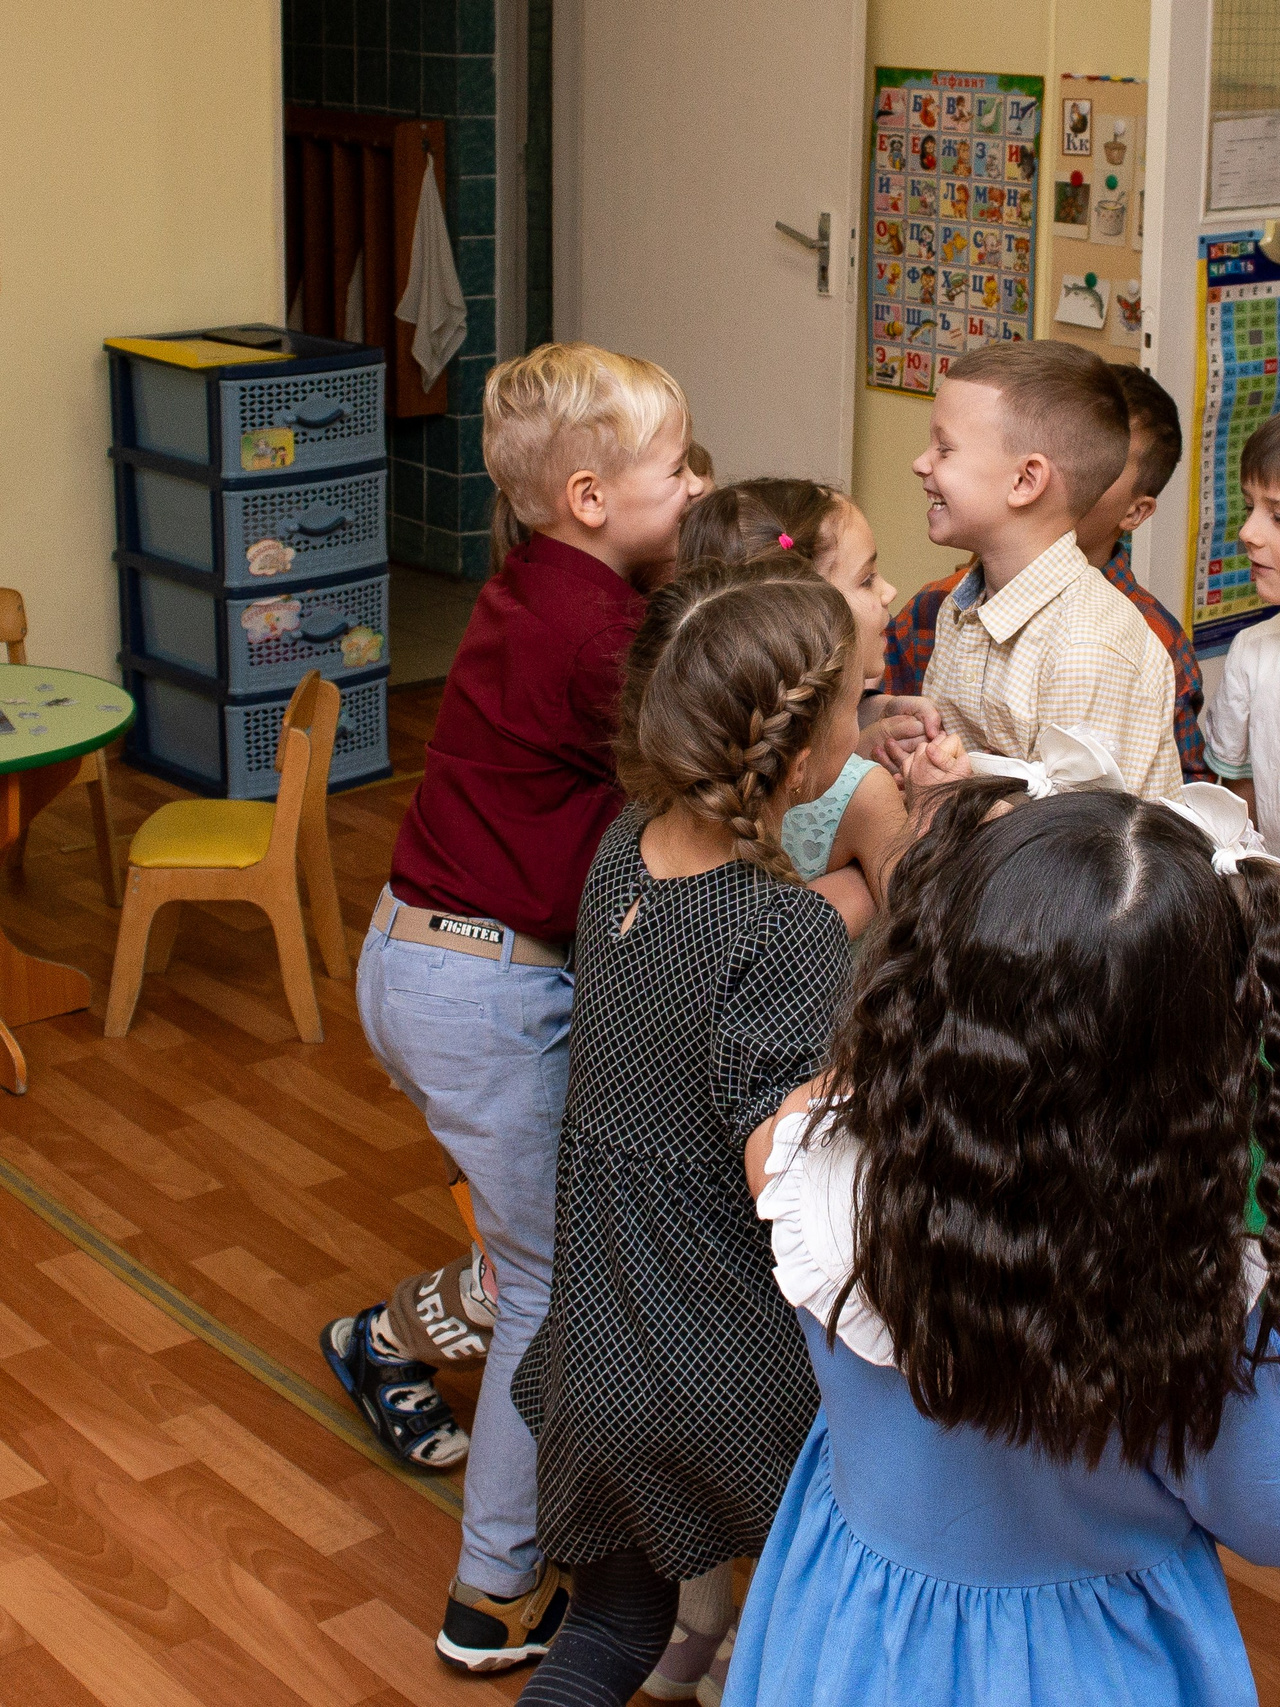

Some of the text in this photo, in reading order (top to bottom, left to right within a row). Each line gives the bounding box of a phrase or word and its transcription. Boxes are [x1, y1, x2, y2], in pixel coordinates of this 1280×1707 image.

[932, 72, 985, 89] Алфавит
[883, 94, 1021, 120] А Б В Г Д
[942, 139, 957, 156] Ж
[976, 142, 986, 159] З
[1008, 145, 1020, 162] И
[1066, 132, 1089, 151] Кк
[911, 180, 921, 196] К
[944, 183, 955, 200] Л
[975, 186, 987, 203] М
[1007, 189, 1018, 206] Н
[876, 220, 1015, 252] О П Р С Т
[876, 263, 1013, 296] У Ф Х Ц Ч
[940, 314, 950, 330] Ъ
[969, 317, 983, 335] Ы
[1002, 321, 1012, 339] Ь
[876, 347, 949, 373] Э Ю Я
[440, 919, 500, 943] FIGHTER
